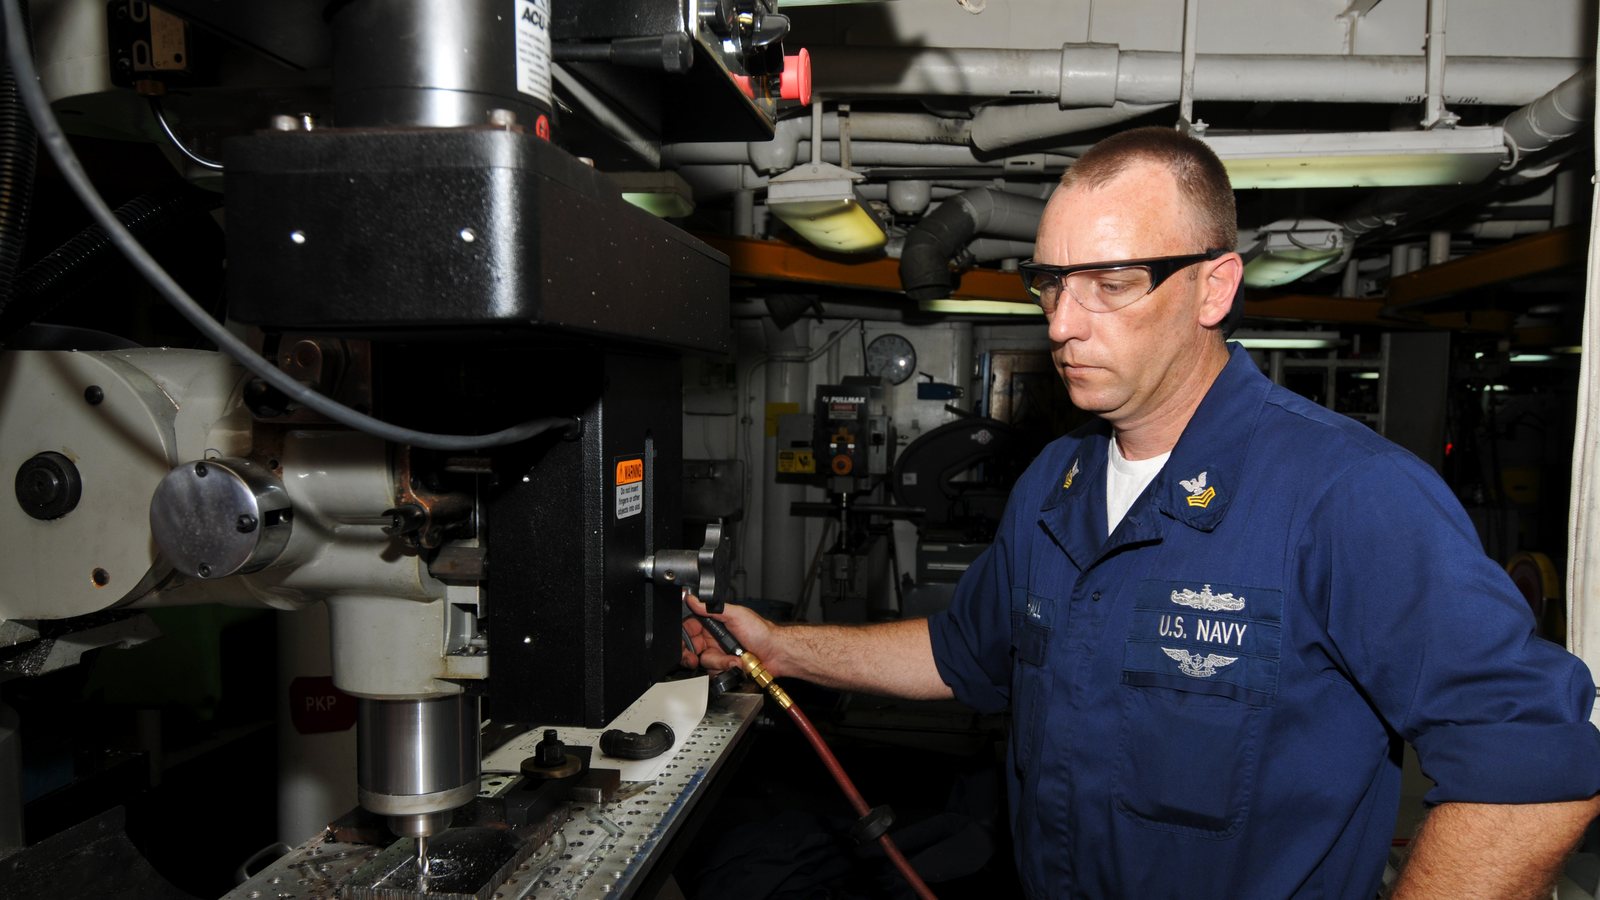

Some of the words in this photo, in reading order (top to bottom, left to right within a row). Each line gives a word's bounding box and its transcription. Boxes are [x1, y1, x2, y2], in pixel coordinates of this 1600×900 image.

[625, 464, 642, 480] WARNING
[1159, 615, 1187, 638] U.S.
[1196, 619, 1247, 646] NAVY
[305, 695, 337, 712] PKP
